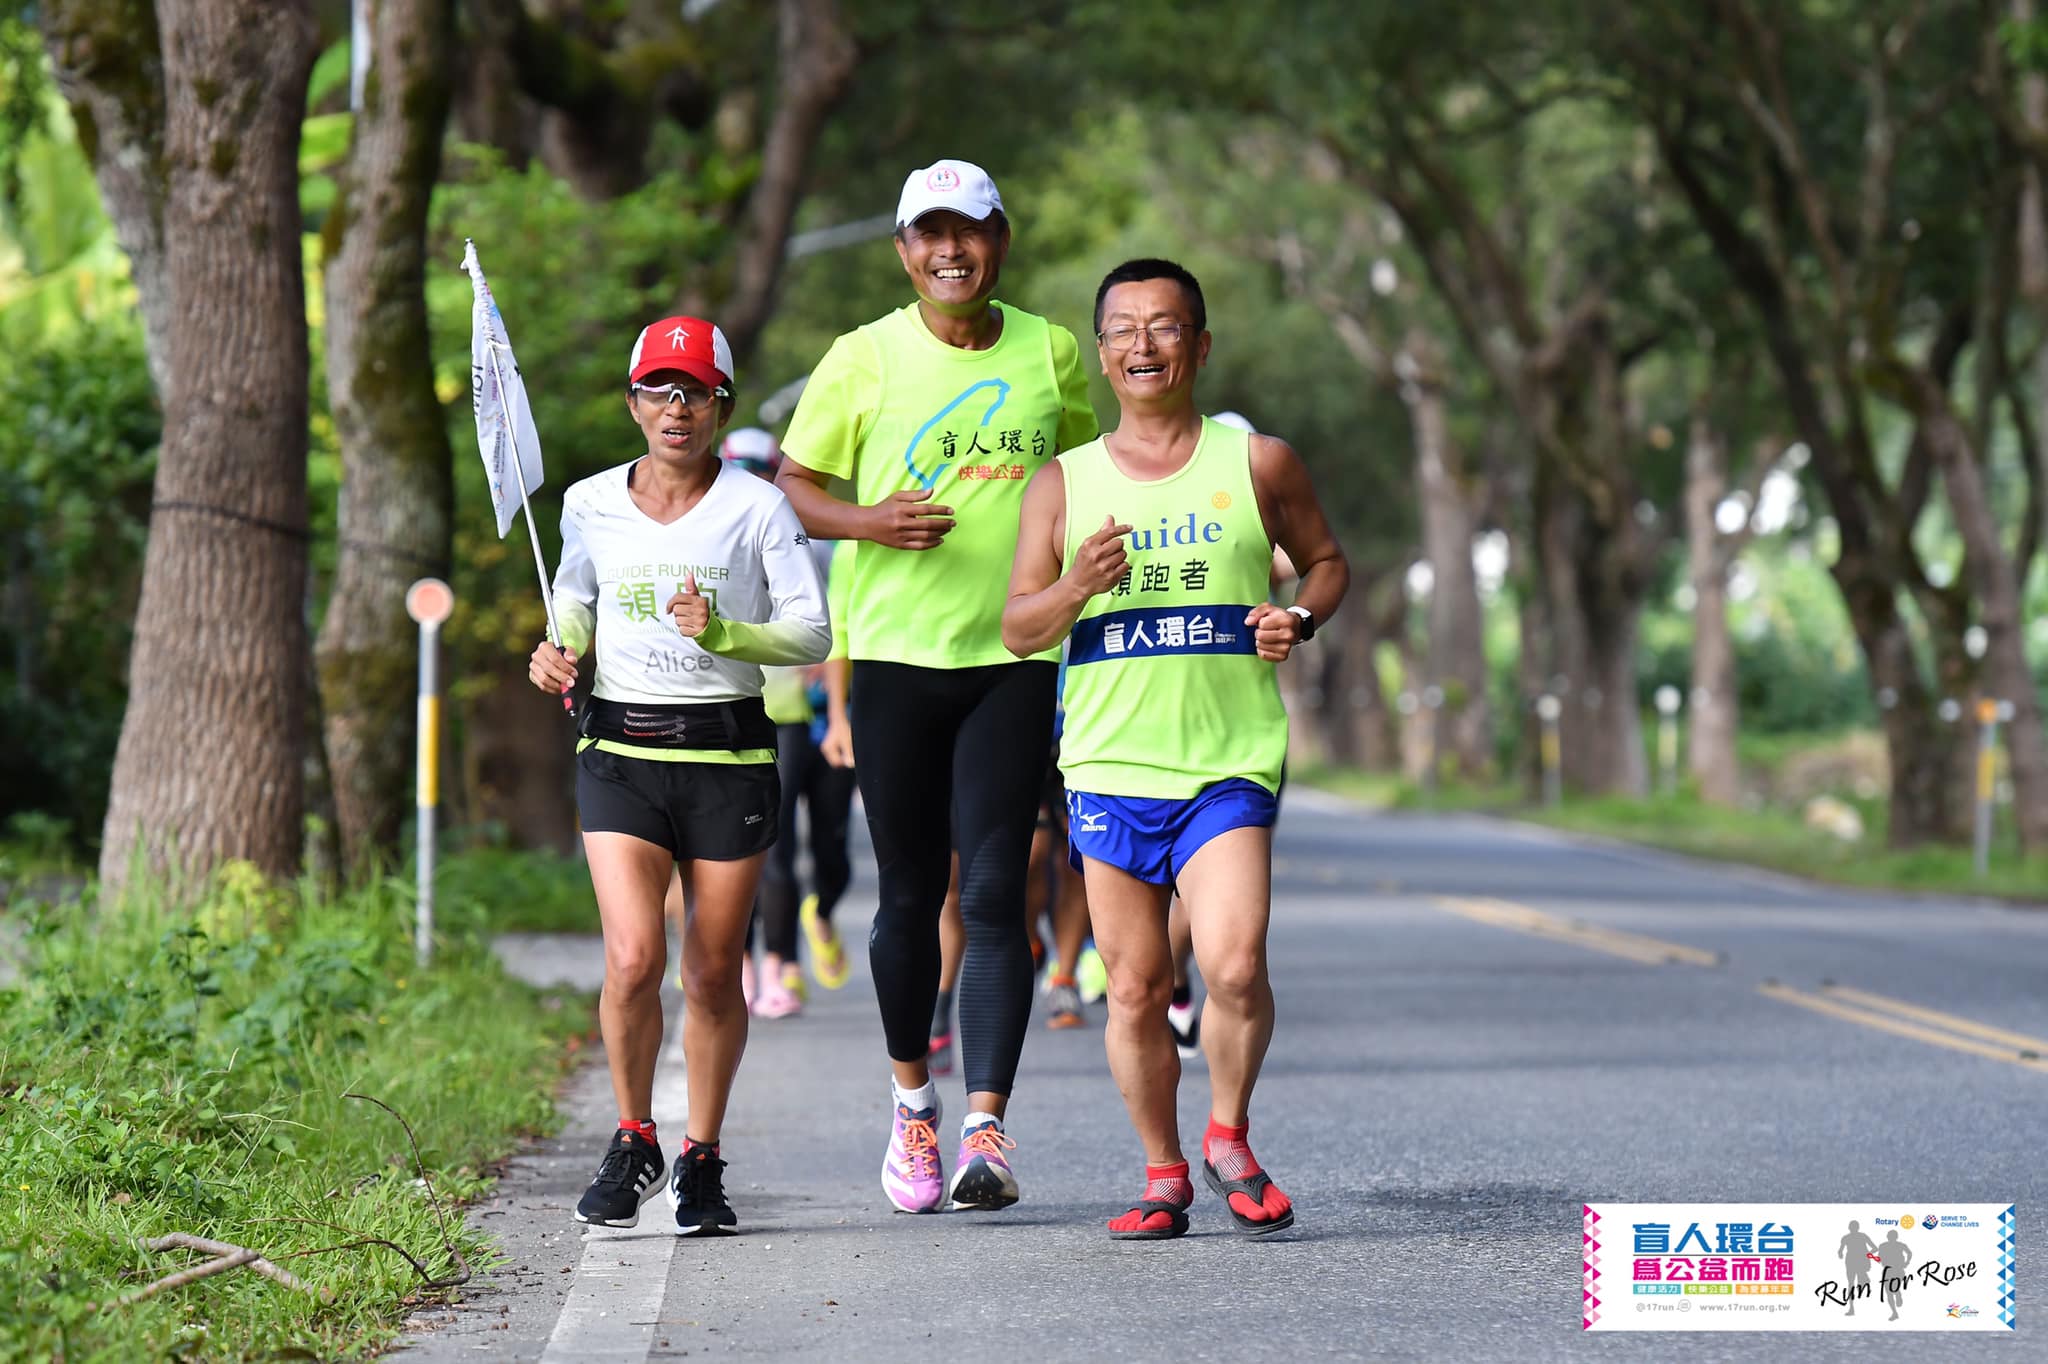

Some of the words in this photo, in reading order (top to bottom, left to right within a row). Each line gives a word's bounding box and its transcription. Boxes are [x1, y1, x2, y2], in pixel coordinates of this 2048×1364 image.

[937, 429, 1046, 459] 盲人環台
[958, 464, 1025, 481] 快樂公益
[1130, 512, 1223, 551] uide
[658, 563, 730, 582] RUNNER
[1103, 613, 1214, 654] 盲人環台
[645, 649, 714, 673] Alice
